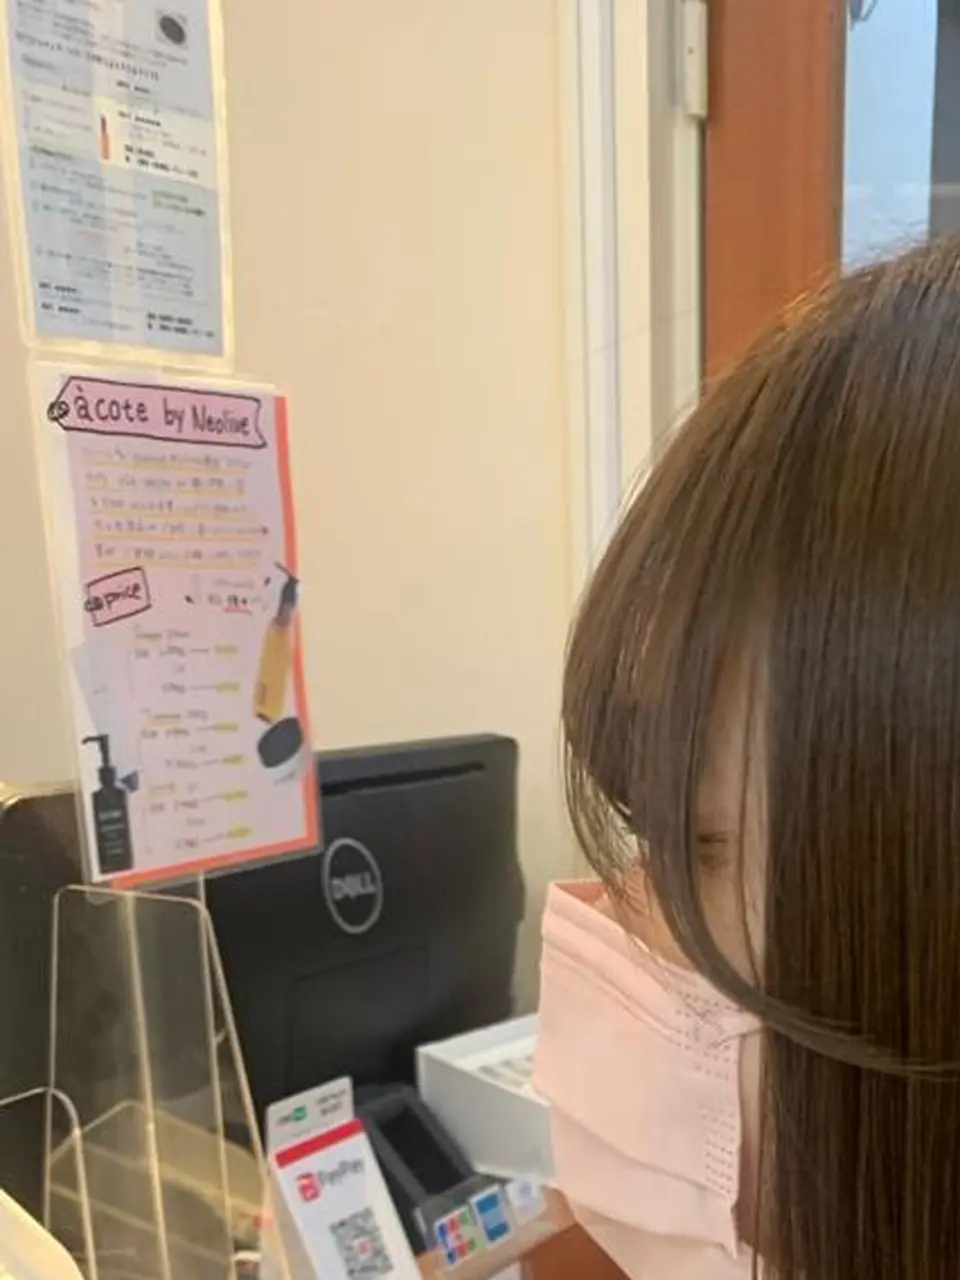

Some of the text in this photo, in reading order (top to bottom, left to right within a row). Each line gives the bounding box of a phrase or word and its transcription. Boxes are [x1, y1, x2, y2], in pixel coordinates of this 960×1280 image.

[163, 397, 185, 433] by
[104, 583, 143, 611] price
[331, 871, 376, 900] DELL
